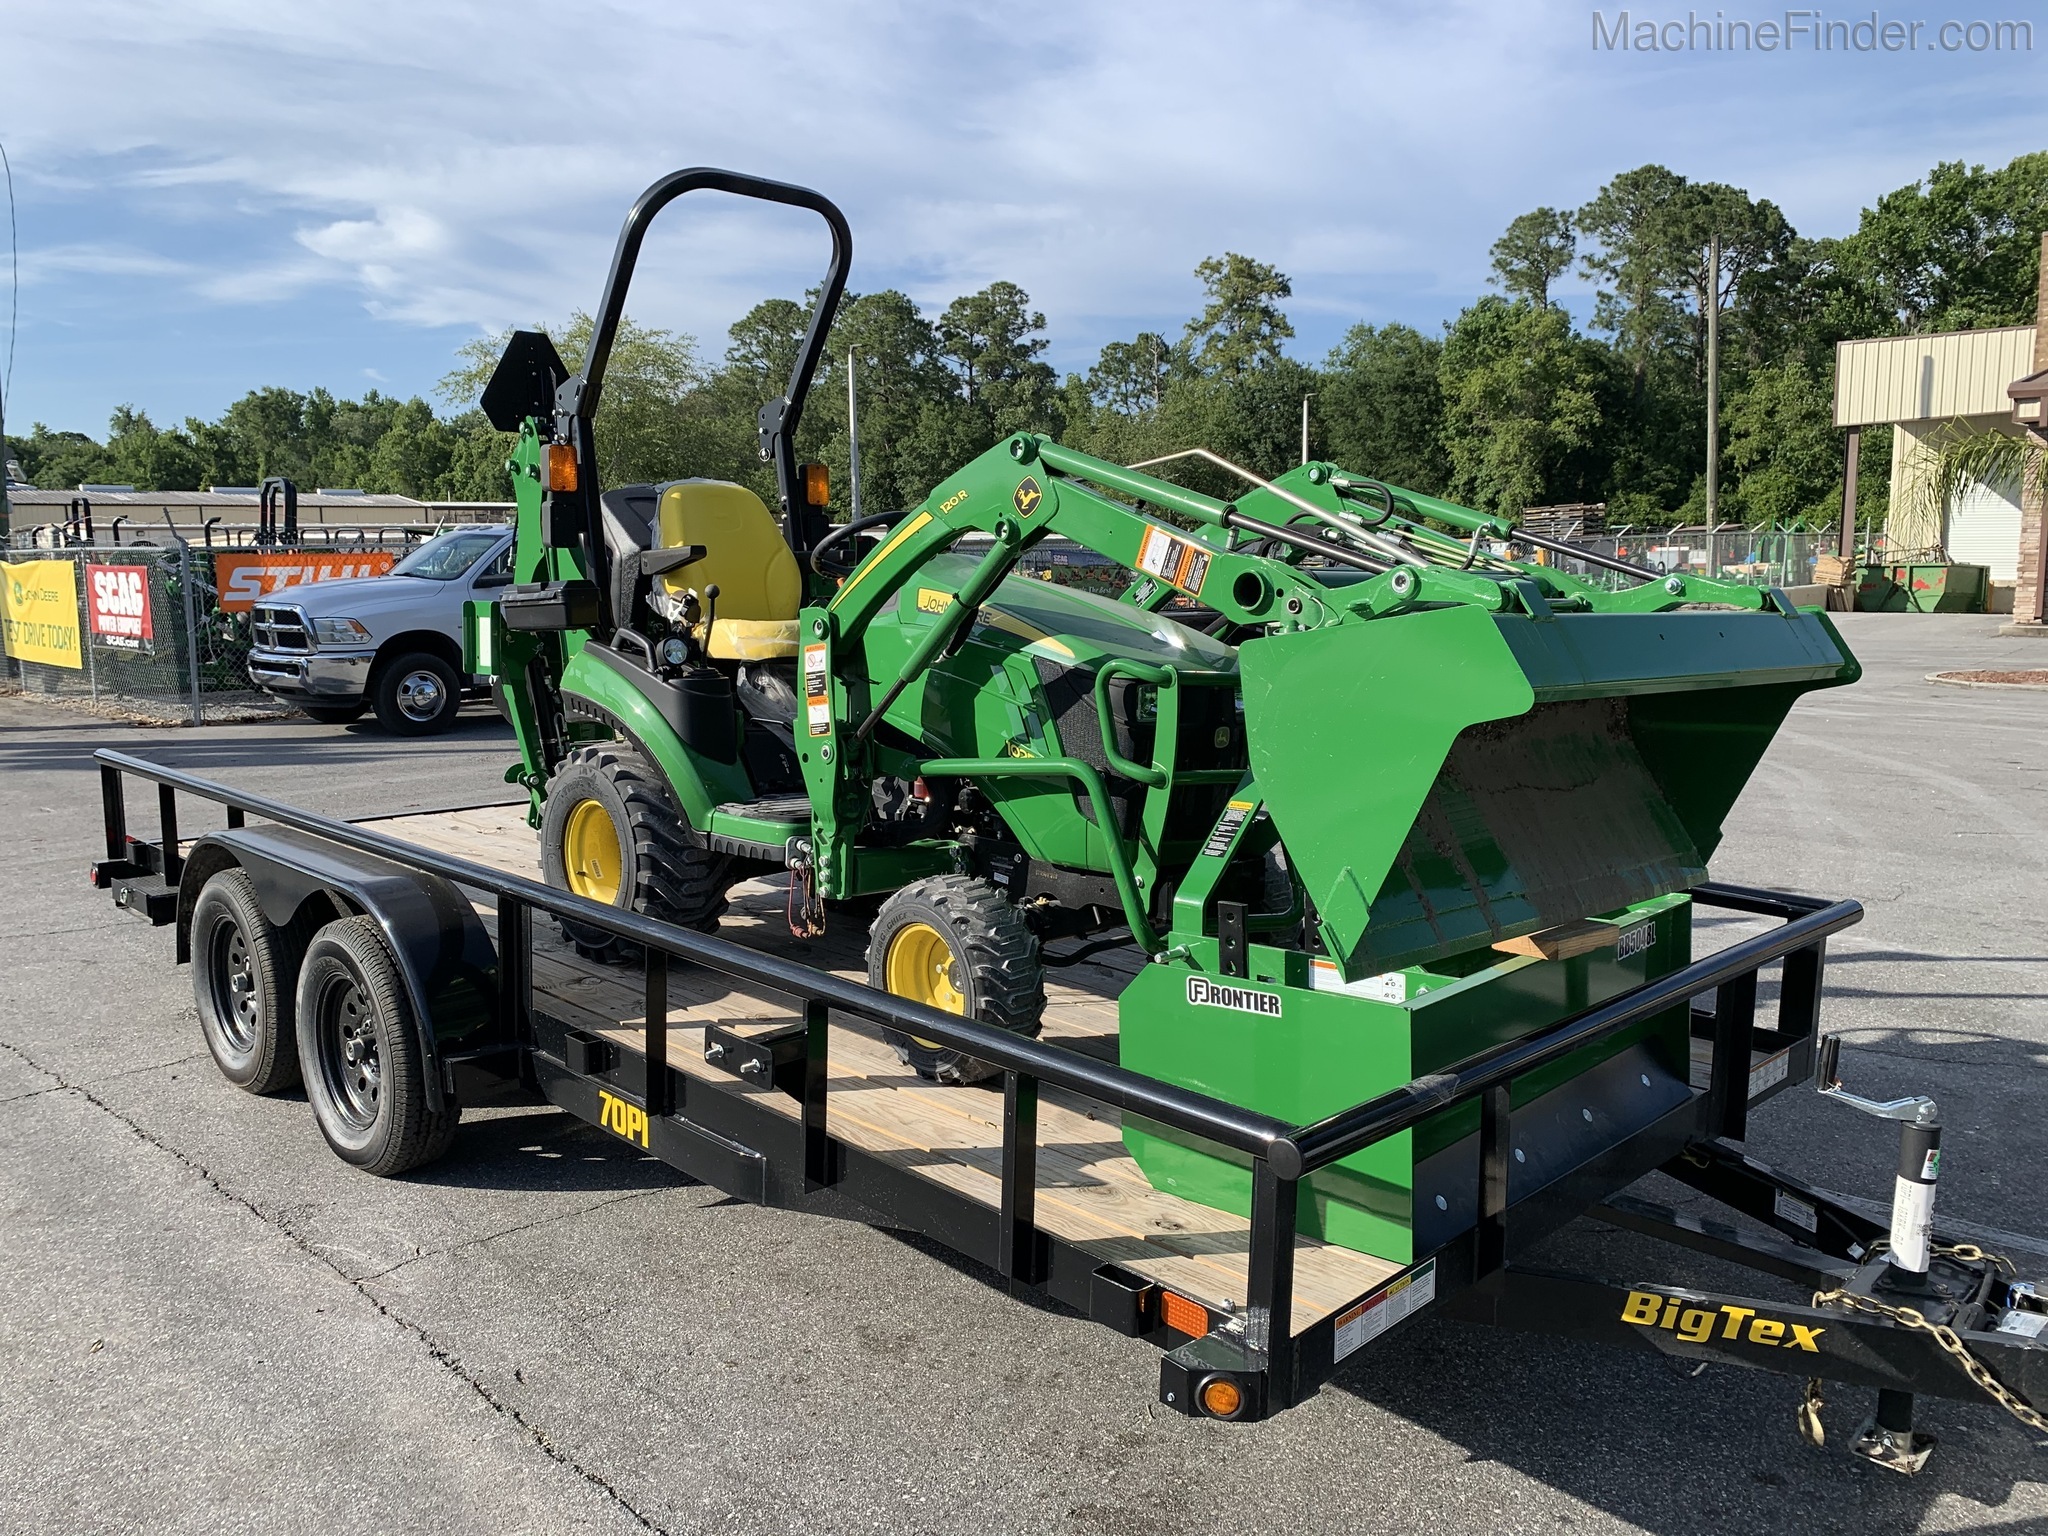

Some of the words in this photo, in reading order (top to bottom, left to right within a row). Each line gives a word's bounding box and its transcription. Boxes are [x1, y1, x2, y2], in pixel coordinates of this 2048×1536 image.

[40, 588, 59, 602] DEERE
[94, 571, 144, 616] SCAG
[23, 622, 46, 647] DRIVE
[47, 624, 76, 651] TODAY!
[1188, 977, 1281, 1015] FRONTIER
[599, 1090, 649, 1149] 70PI
